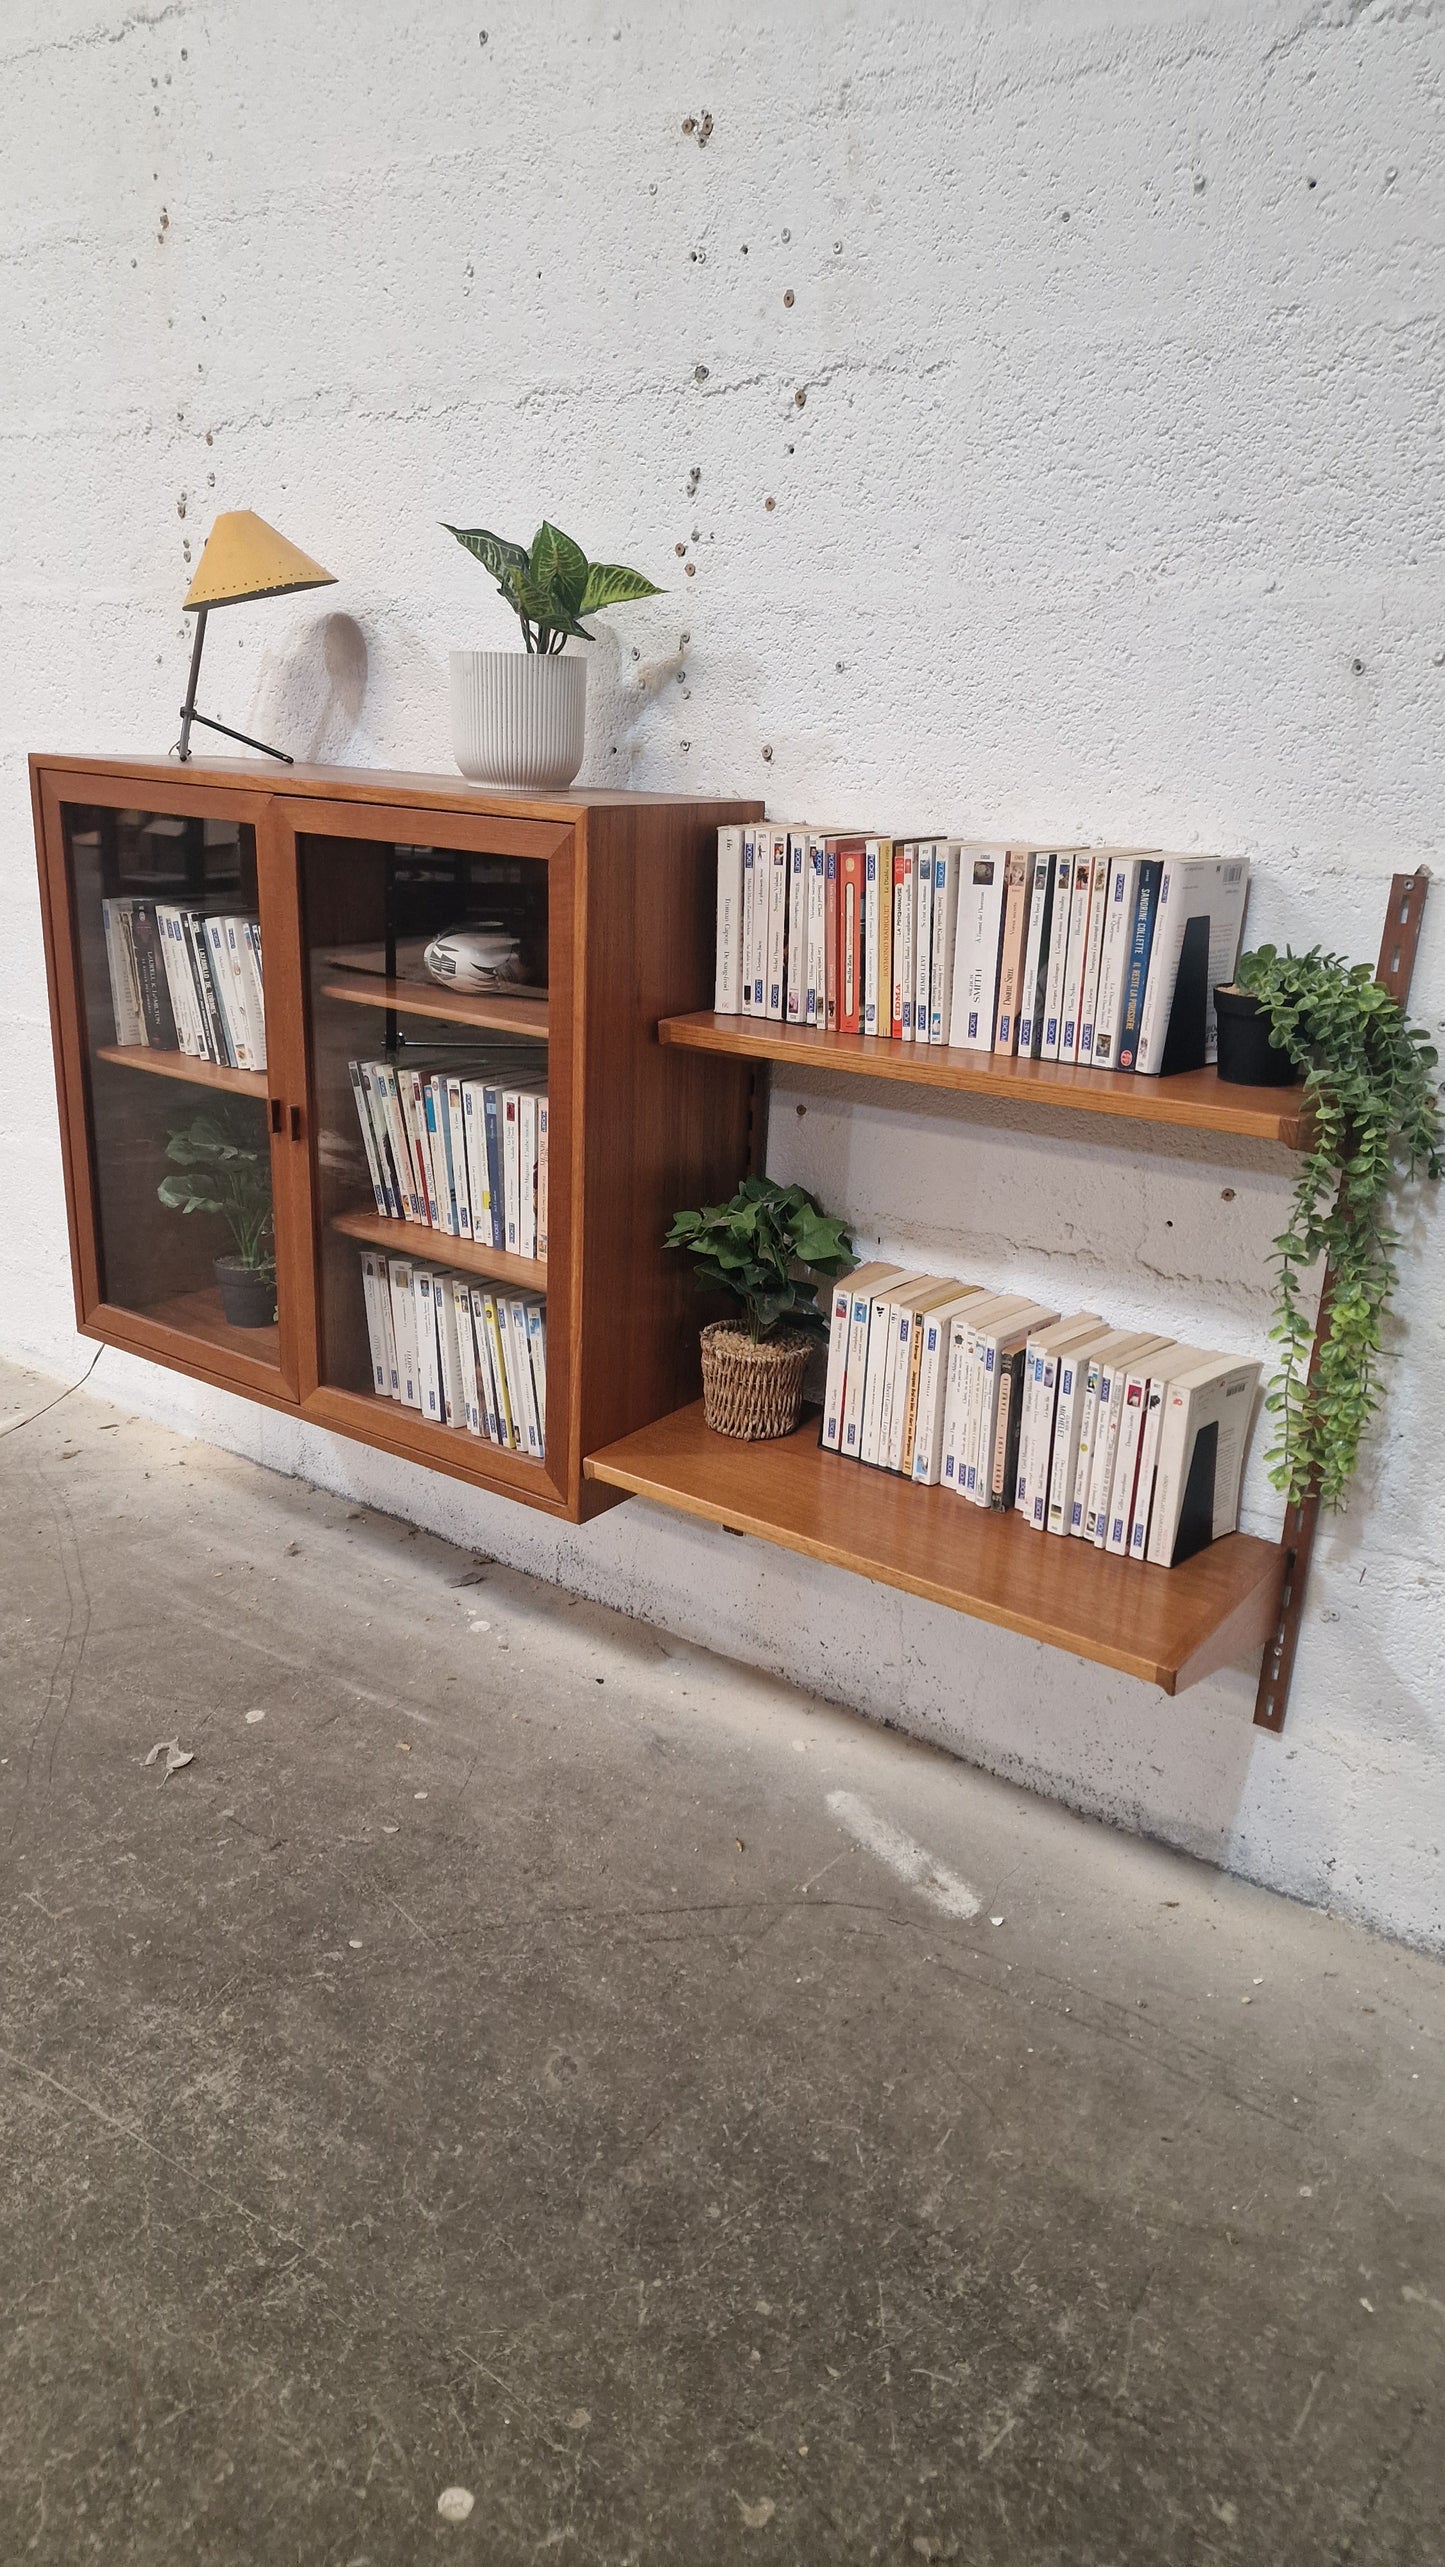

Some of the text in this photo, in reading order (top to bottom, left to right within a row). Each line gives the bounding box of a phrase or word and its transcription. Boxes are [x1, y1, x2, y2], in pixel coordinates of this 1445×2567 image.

[1115, 873, 1125, 902] POCKET
[1139, 888, 1150, 921] SANDRINE
[1134, 923, 1147, 955] COLLETTE
[973, 969, 982, 1004] SMITH
[1131, 970, 1140, 989] RESTE
[1130, 989, 1138, 998] LA
[968, 1012, 977, 1039] POCKET
[1000, 1016, 1009, 1042] POCKET
[1021, 1020, 1030, 1046] POCKET
[1046, 1019, 1057, 1046] POCKET
[1064, 1021, 1074, 1049] POCKET
[1082, 1024, 1091, 1051] POCKET
[1063, 1370, 1072, 1395] POCKET
[1101, 1377, 1110, 1403] POCKET
[1057, 1405, 1065, 1439] MICHELET
[1072, 1503, 1081, 1527] POCKET
[1112, 1519, 1122, 1543] POCKET
[1134, 1524, 1143, 1549] POCKET
